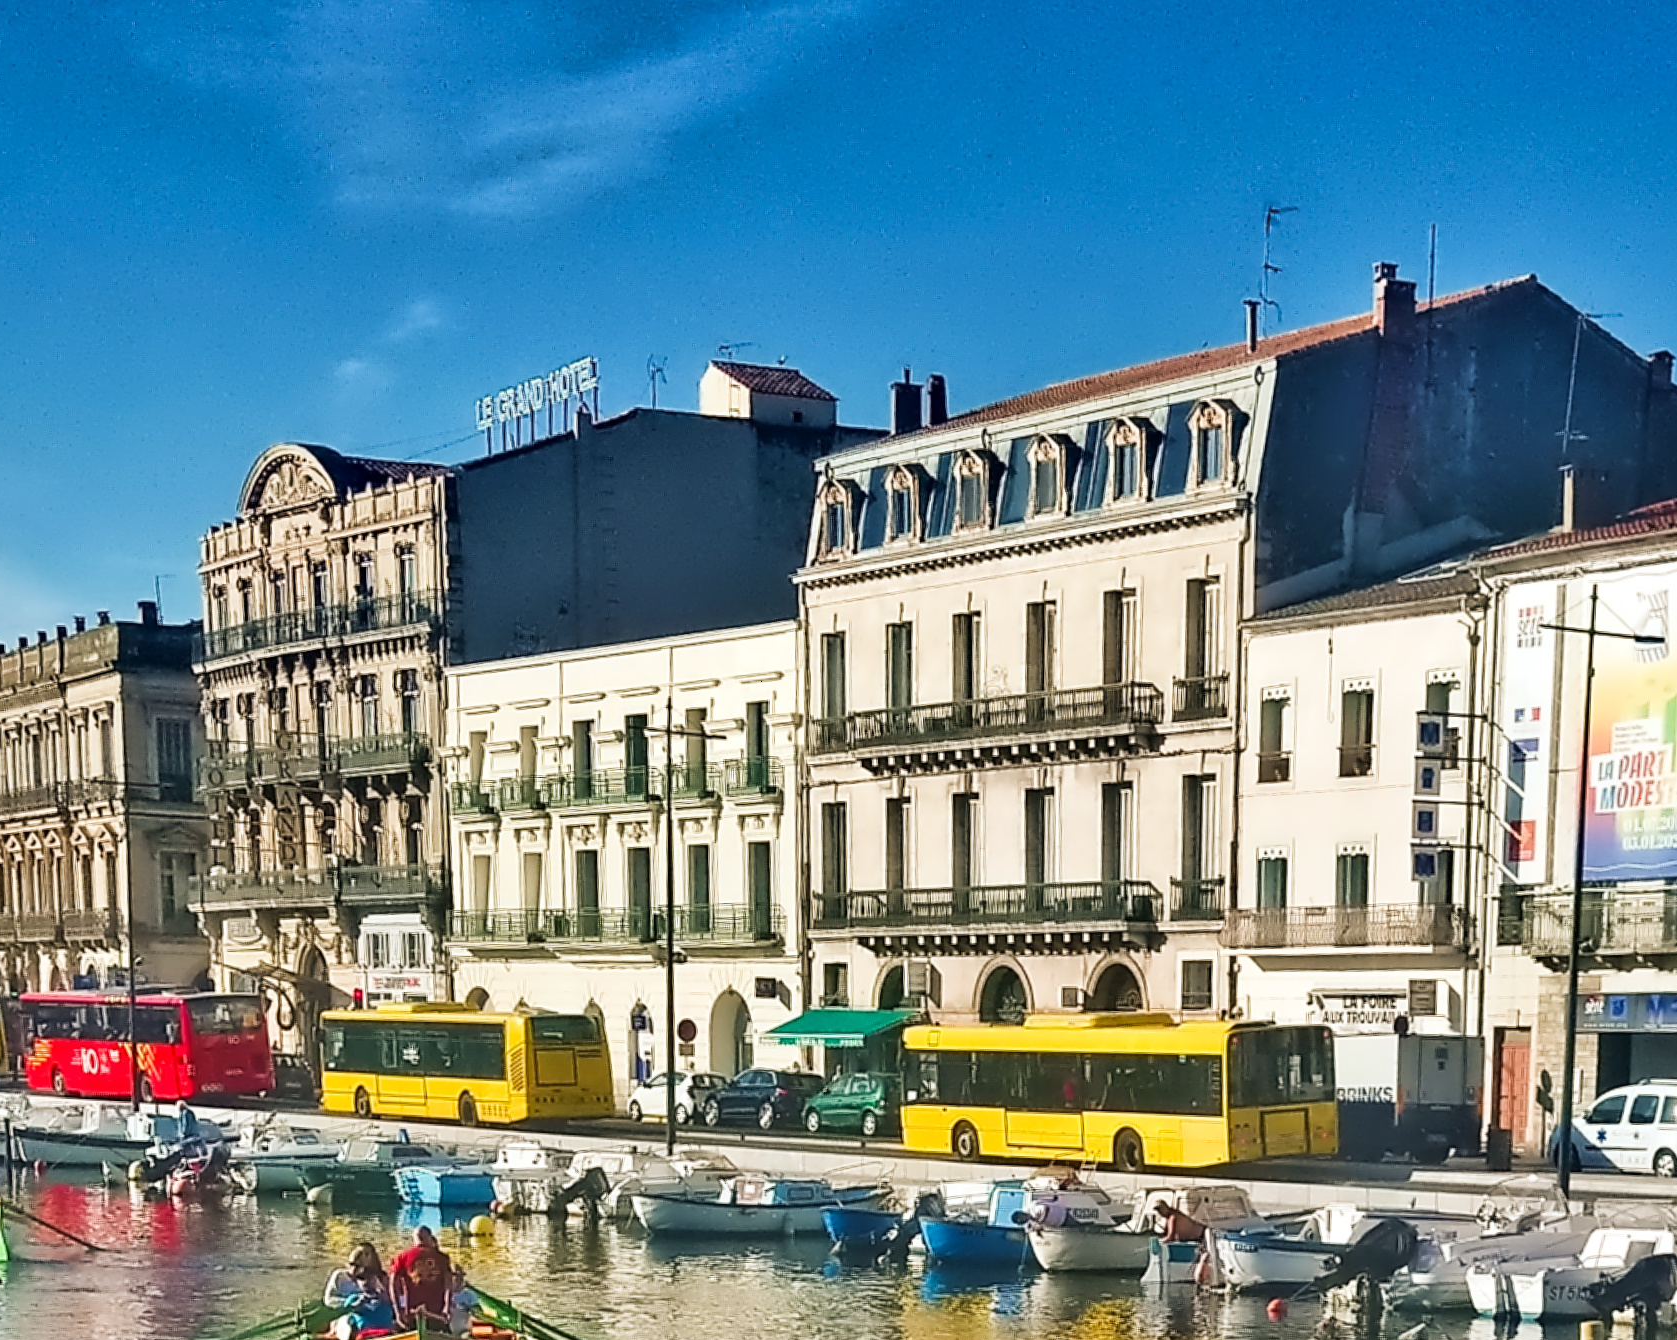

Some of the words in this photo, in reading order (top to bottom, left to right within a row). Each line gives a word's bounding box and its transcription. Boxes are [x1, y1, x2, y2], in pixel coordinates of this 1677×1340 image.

[475, 395, 494, 430] LE
[498, 378, 545, 422] GRAND
[1598, 759, 1615, 781] LA
[1618, 749, 1668, 780] PART
[1343, 994, 1357, 1009] LA
[1361, 994, 1398, 1009] FOIRE
[1323, 1011, 1345, 1024] AUX
[1336, 1086, 1394, 1103] BRINKS
